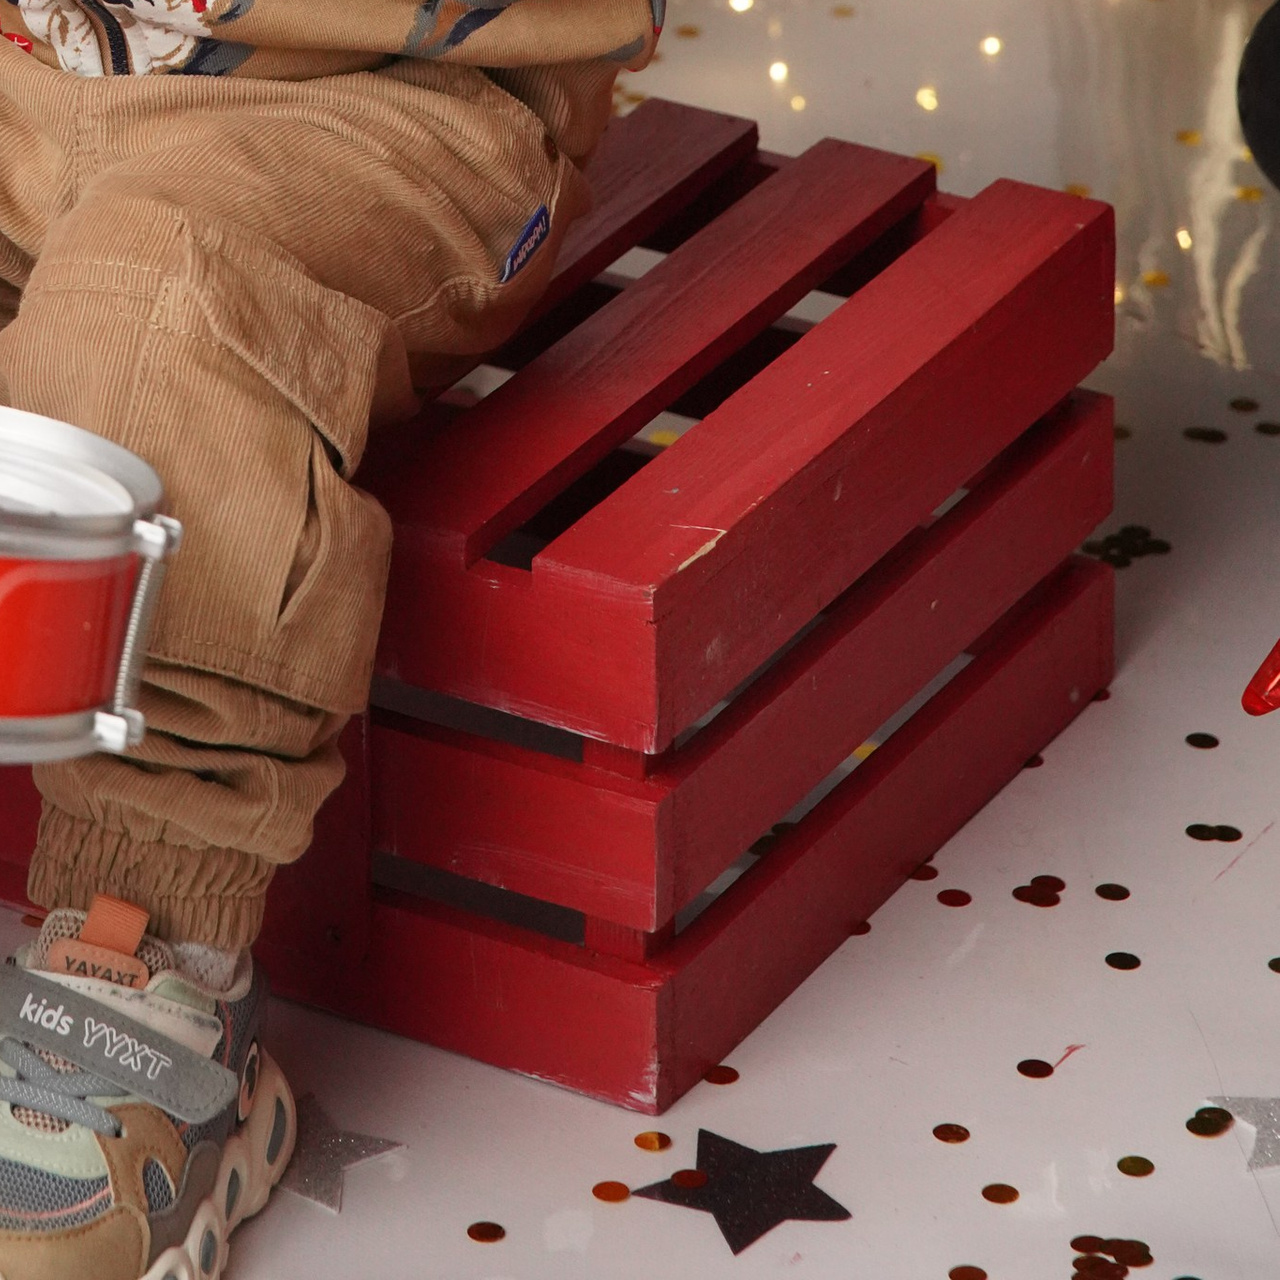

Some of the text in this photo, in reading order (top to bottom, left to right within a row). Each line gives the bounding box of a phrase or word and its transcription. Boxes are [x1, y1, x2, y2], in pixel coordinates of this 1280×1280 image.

[64, 955, 139, 988] YAYAXT
[19, 992, 173, 1080] kids YYXT
